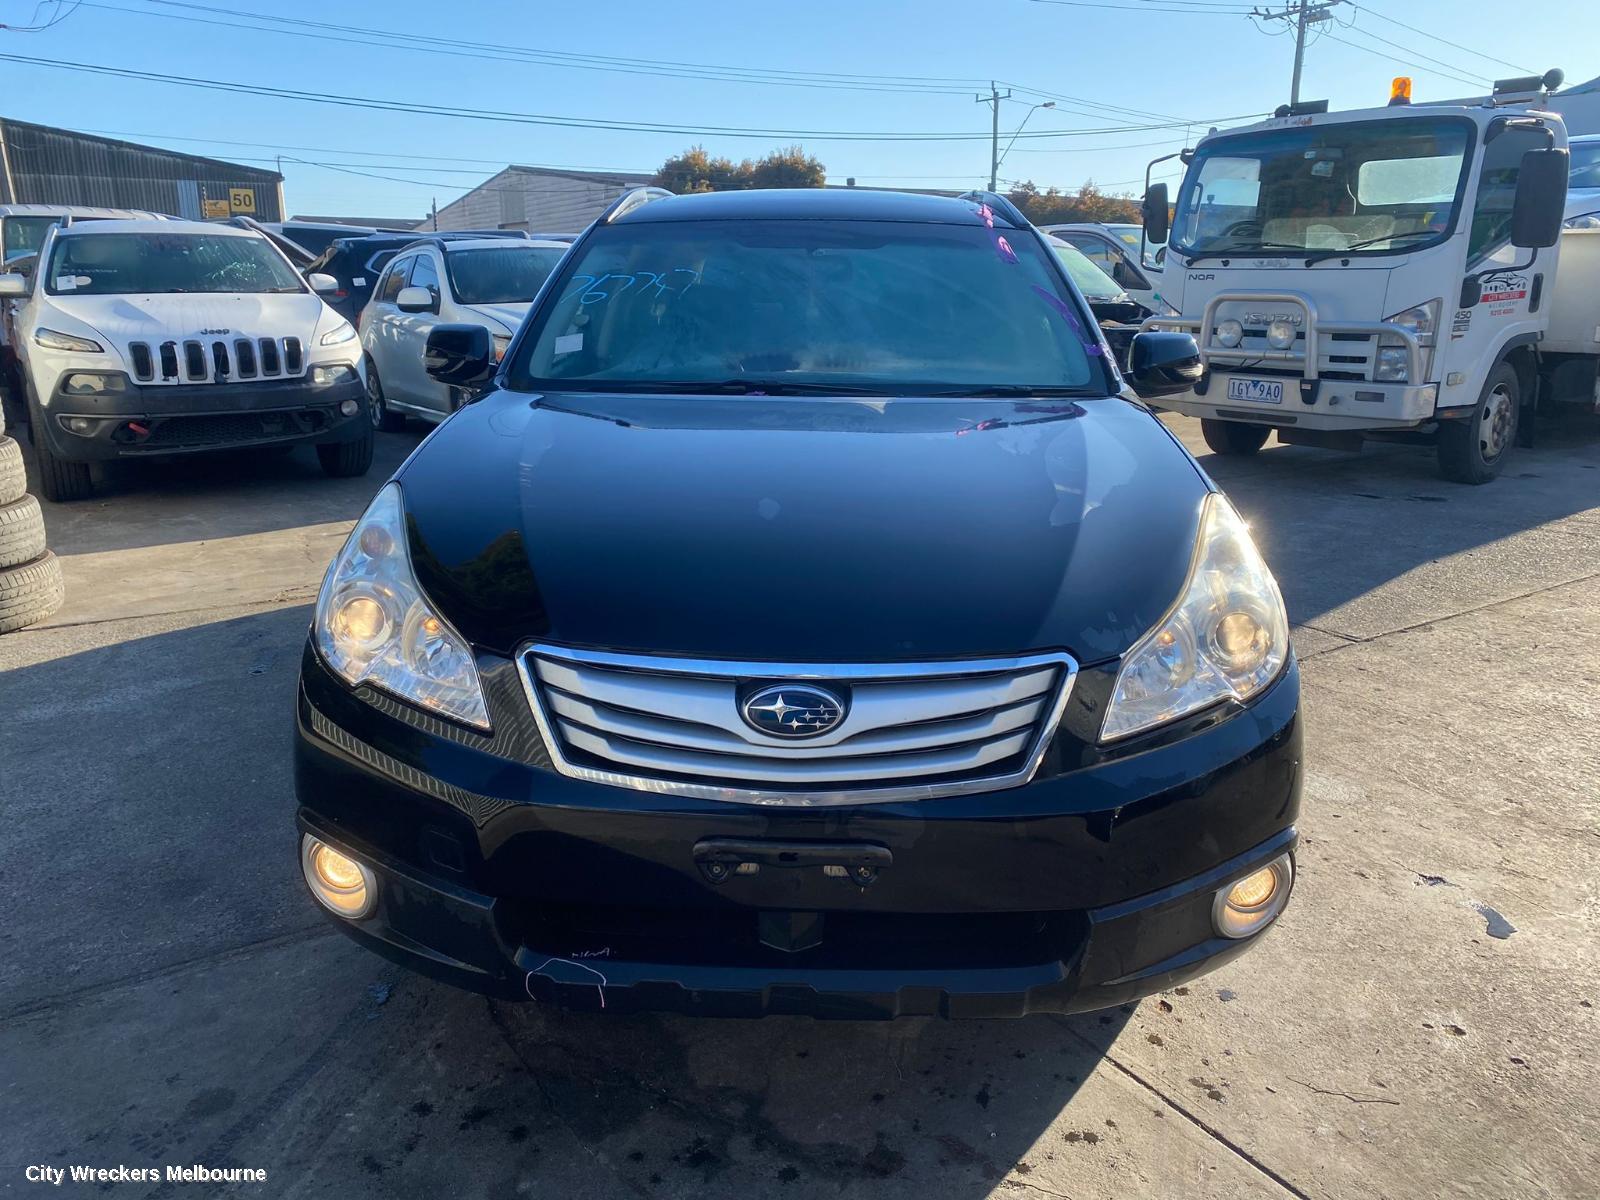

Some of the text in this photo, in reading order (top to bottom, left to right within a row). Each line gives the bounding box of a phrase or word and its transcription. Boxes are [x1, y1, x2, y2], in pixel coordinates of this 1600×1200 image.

[233, 194, 252, 207] 50
[1244, 312, 1303, 326] ISUZU
[1455, 310, 1472, 319] 450
[1231, 381, 1251, 396] 1GY
